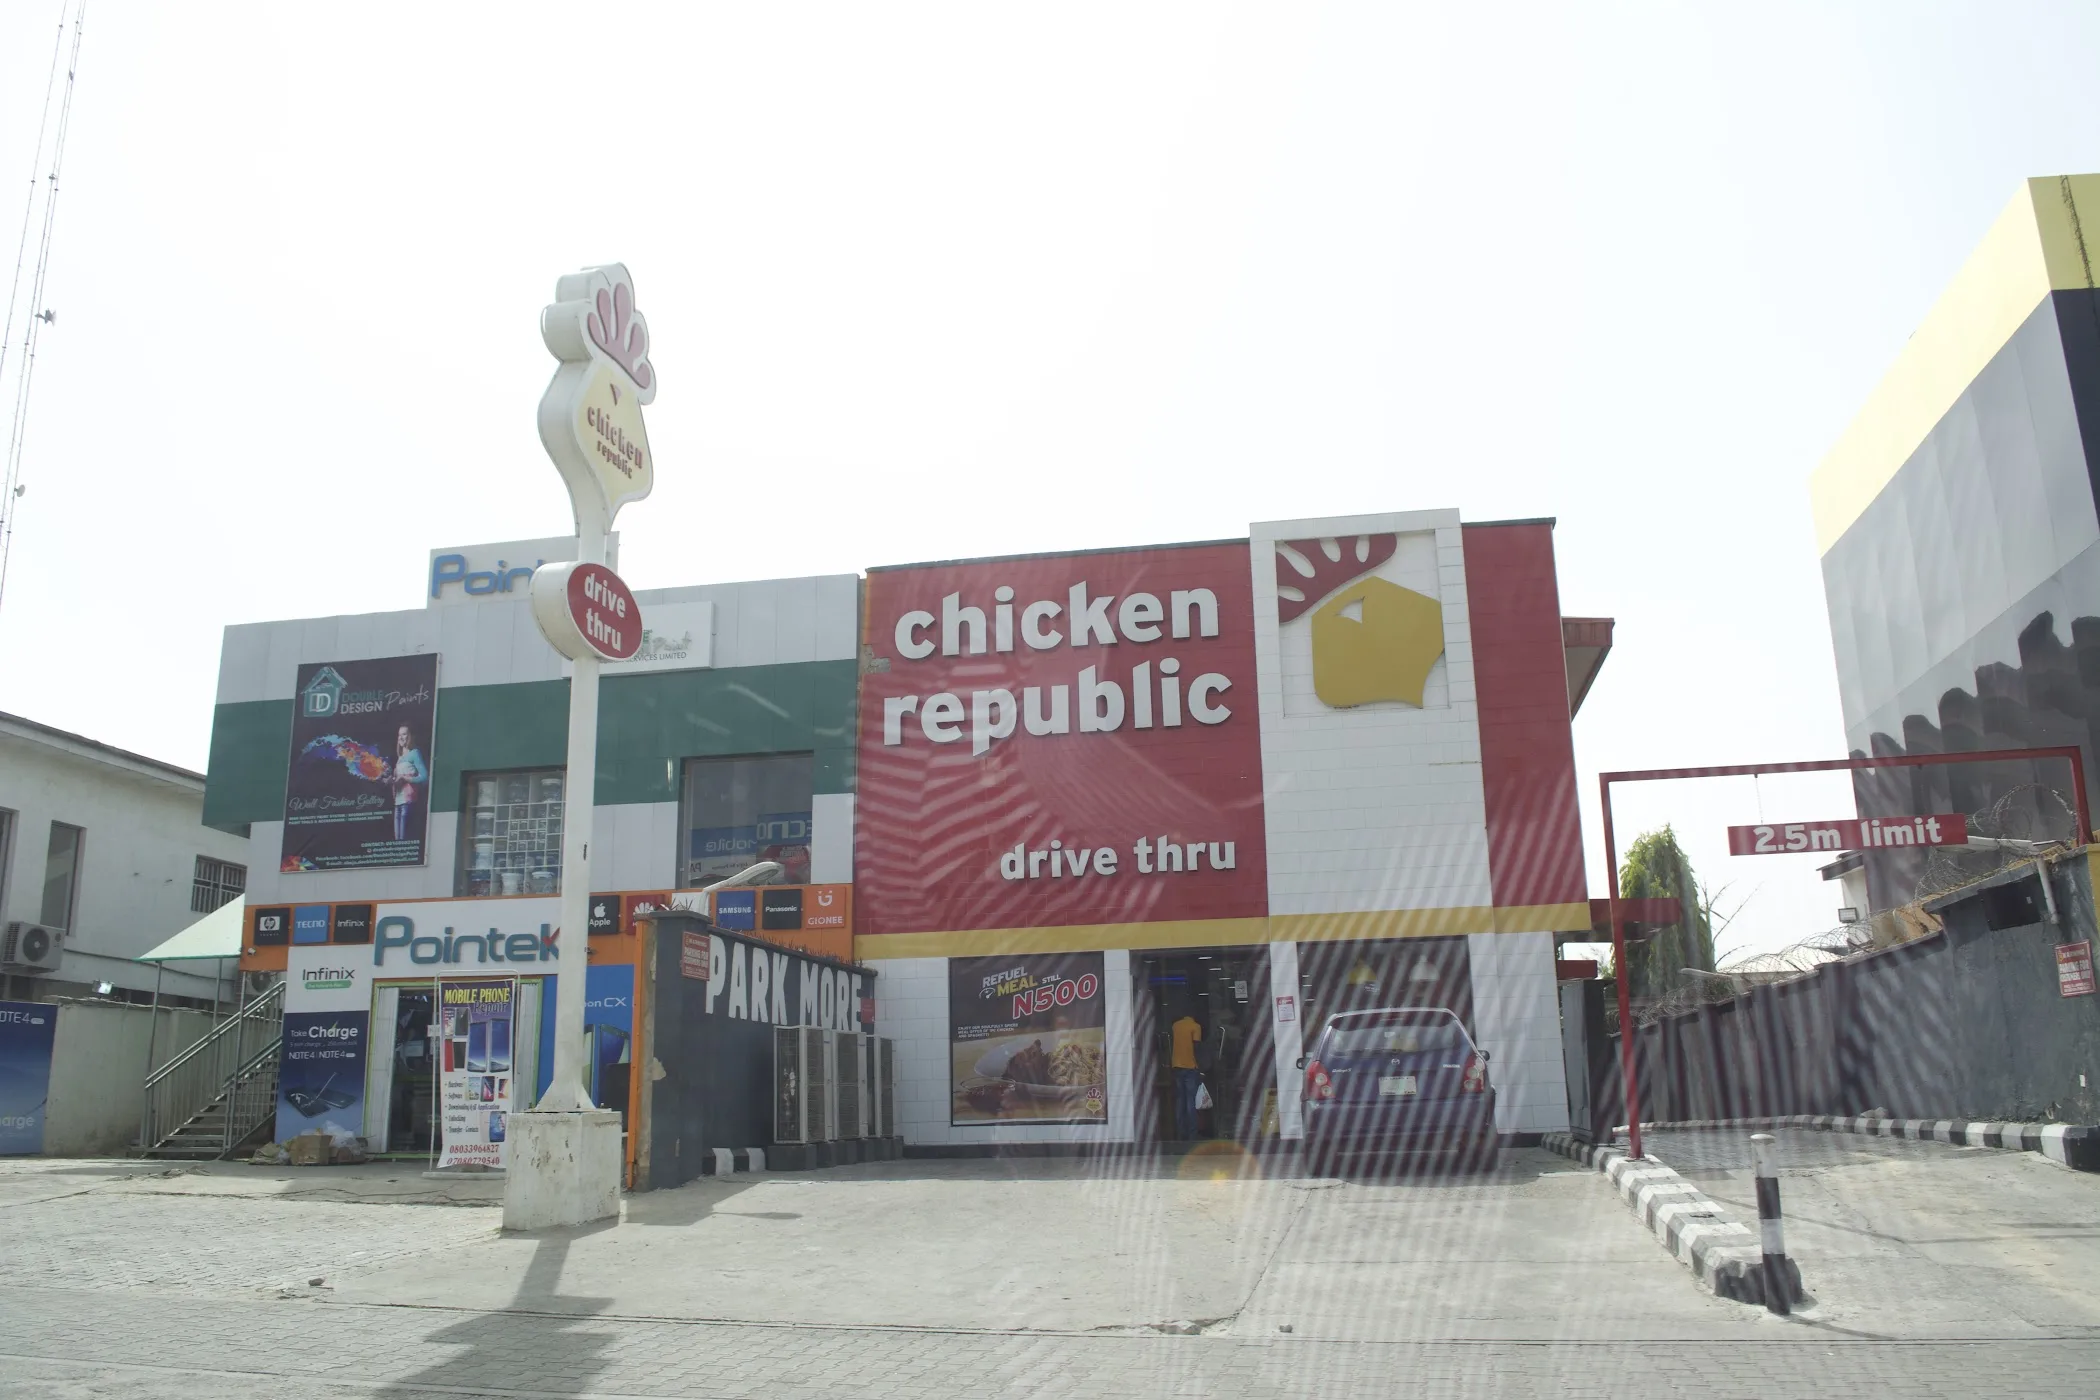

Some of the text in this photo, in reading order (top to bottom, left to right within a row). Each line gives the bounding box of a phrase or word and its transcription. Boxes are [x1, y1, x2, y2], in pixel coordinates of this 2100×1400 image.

[587, 406, 643, 469] chicken
[597, 439, 633, 479] republic
[432, 554, 545, 599] Poin
[585, 573, 626, 618] drive
[586, 608, 622, 652] thru
[895, 580, 1219, 659] chicken
[659, 651, 687, 660] LIMITED
[340, 701, 383, 714] DESIGN
[342, 683, 430, 711] DOUBLE Paints
[884, 657, 1233, 757] republic
[1753, 816, 1942, 852] 2.5m limit
[1000, 835, 1236, 881] drive thru
[719, 906, 752, 914] SAMSUNG
[765, 905, 797, 913] Panasonic
[296, 919, 326, 929] TECNO
[337, 919, 365, 928] Infinix
[589, 919, 611, 928] Apple
[808, 916, 843, 925] GIONEE
[374, 916, 560, 966] Pointek
[302, 967, 355, 981] Infinix
[706, 934, 862, 1032] PARK MORE
[982, 966, 1028, 988] REFUEL
[444, 987, 510, 1004] MOBILE PHONE
[997, 974, 1061, 997] MEAL STILL
[1012, 973, 1098, 1020] N500
[604, 997, 627, 1008] CX
[308, 1026, 358, 1040] Charge
[0, 1116, 35, 1129] arge
